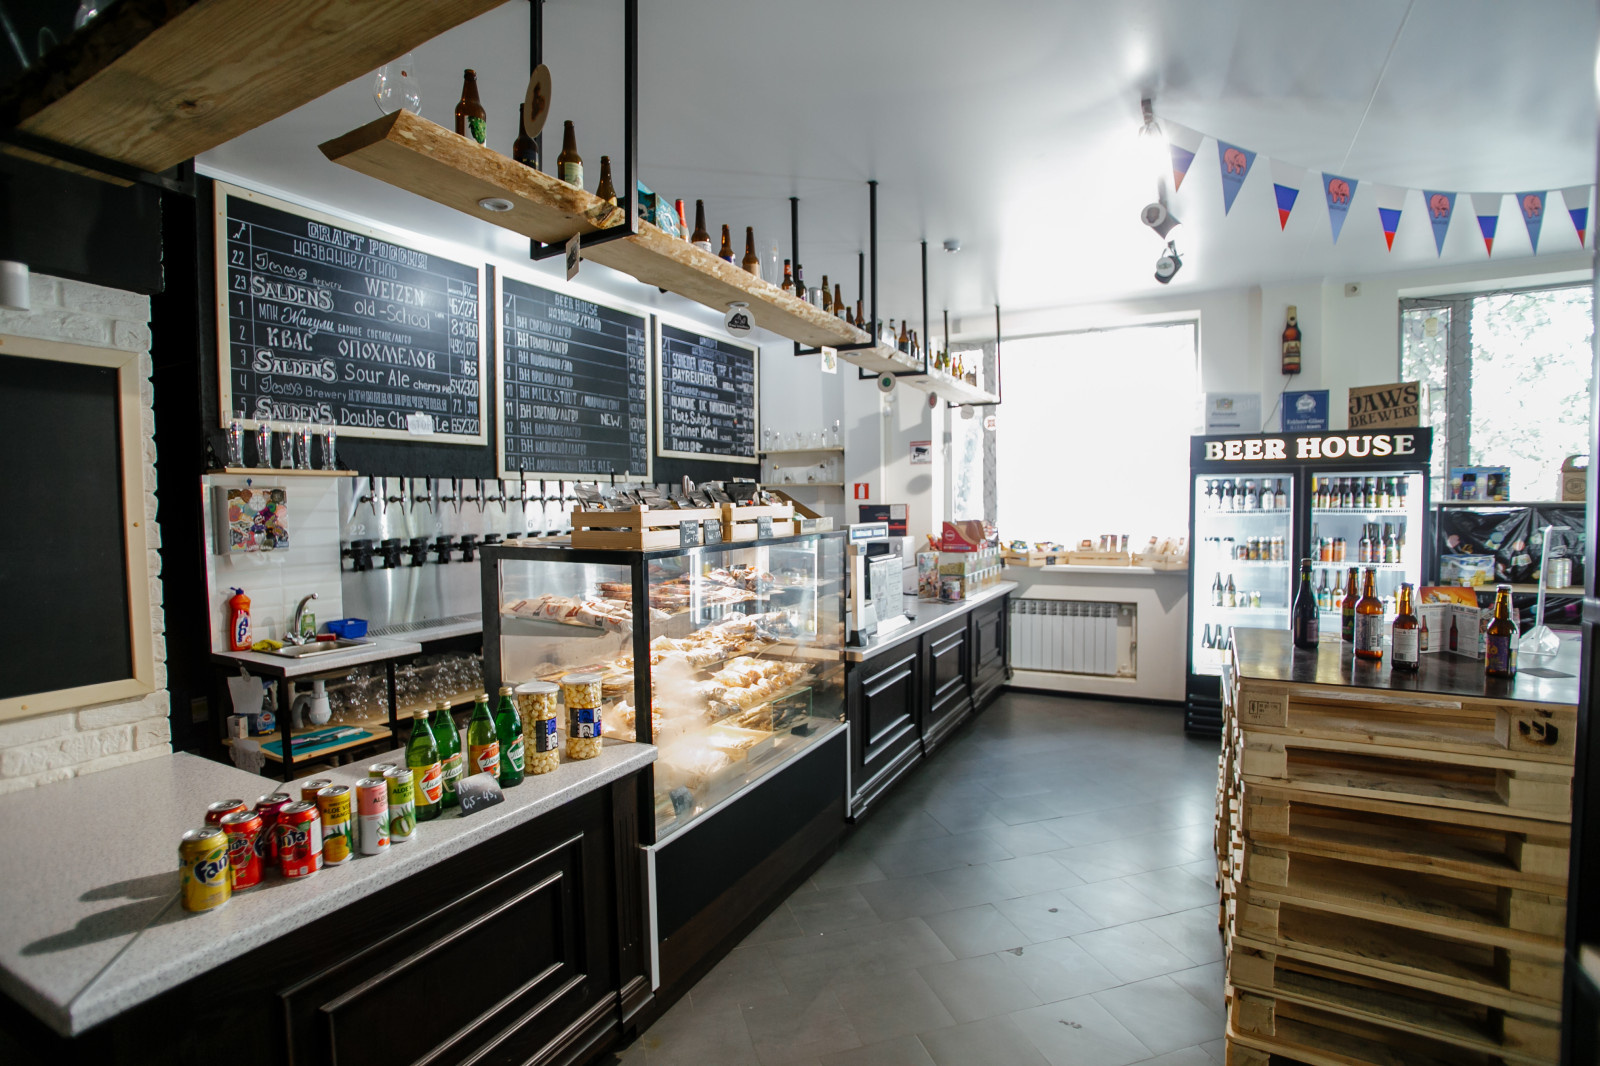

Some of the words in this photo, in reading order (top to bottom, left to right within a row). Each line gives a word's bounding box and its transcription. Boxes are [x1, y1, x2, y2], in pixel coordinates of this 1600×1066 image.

[307, 221, 364, 251] CRAFT
[369, 239, 428, 270] РОССИЯ
[231, 249, 245, 266] 22
[364, 277, 425, 308] WEIZEN
[235, 275, 247, 291] 23
[239, 300, 244, 316] 1
[554, 293, 574, 310] BEER
[574, 299, 599, 317] HOUSE
[240, 325, 246, 341] 2
[267, 326, 313, 351] КВАС
[338, 338, 436, 370] ОПОХМЕЛОВ
[464, 360, 477, 377] 65
[240, 348, 246, 365] 3
[344, 362, 384, 384] Sour
[387, 368, 410, 389] Ale
[413, 380, 440, 394] cherry
[671, 367, 718, 388] BAYREUTHER
[240, 374, 247, 391] 4
[305, 385, 347, 402] Brewery
[531, 387, 552, 402] MILK
[553, 390, 577, 406] STOUT
[505, 401, 513, 416] 11
[1349, 385, 1419, 415] JAWS
[340, 407, 385, 429] Double
[505, 421, 513, 434] 12
[1350, 404, 1419, 428] BREWERY
[671, 423, 700, 438] Berliner
[701, 426, 718, 440] Kindl
[1204, 438, 1287, 461] BEER
[1296, 434, 1416, 460] HOUSE
[350, 524, 366, 536] 22
[280, 829, 308, 848] nta
[193, 846, 229, 884] Fan
